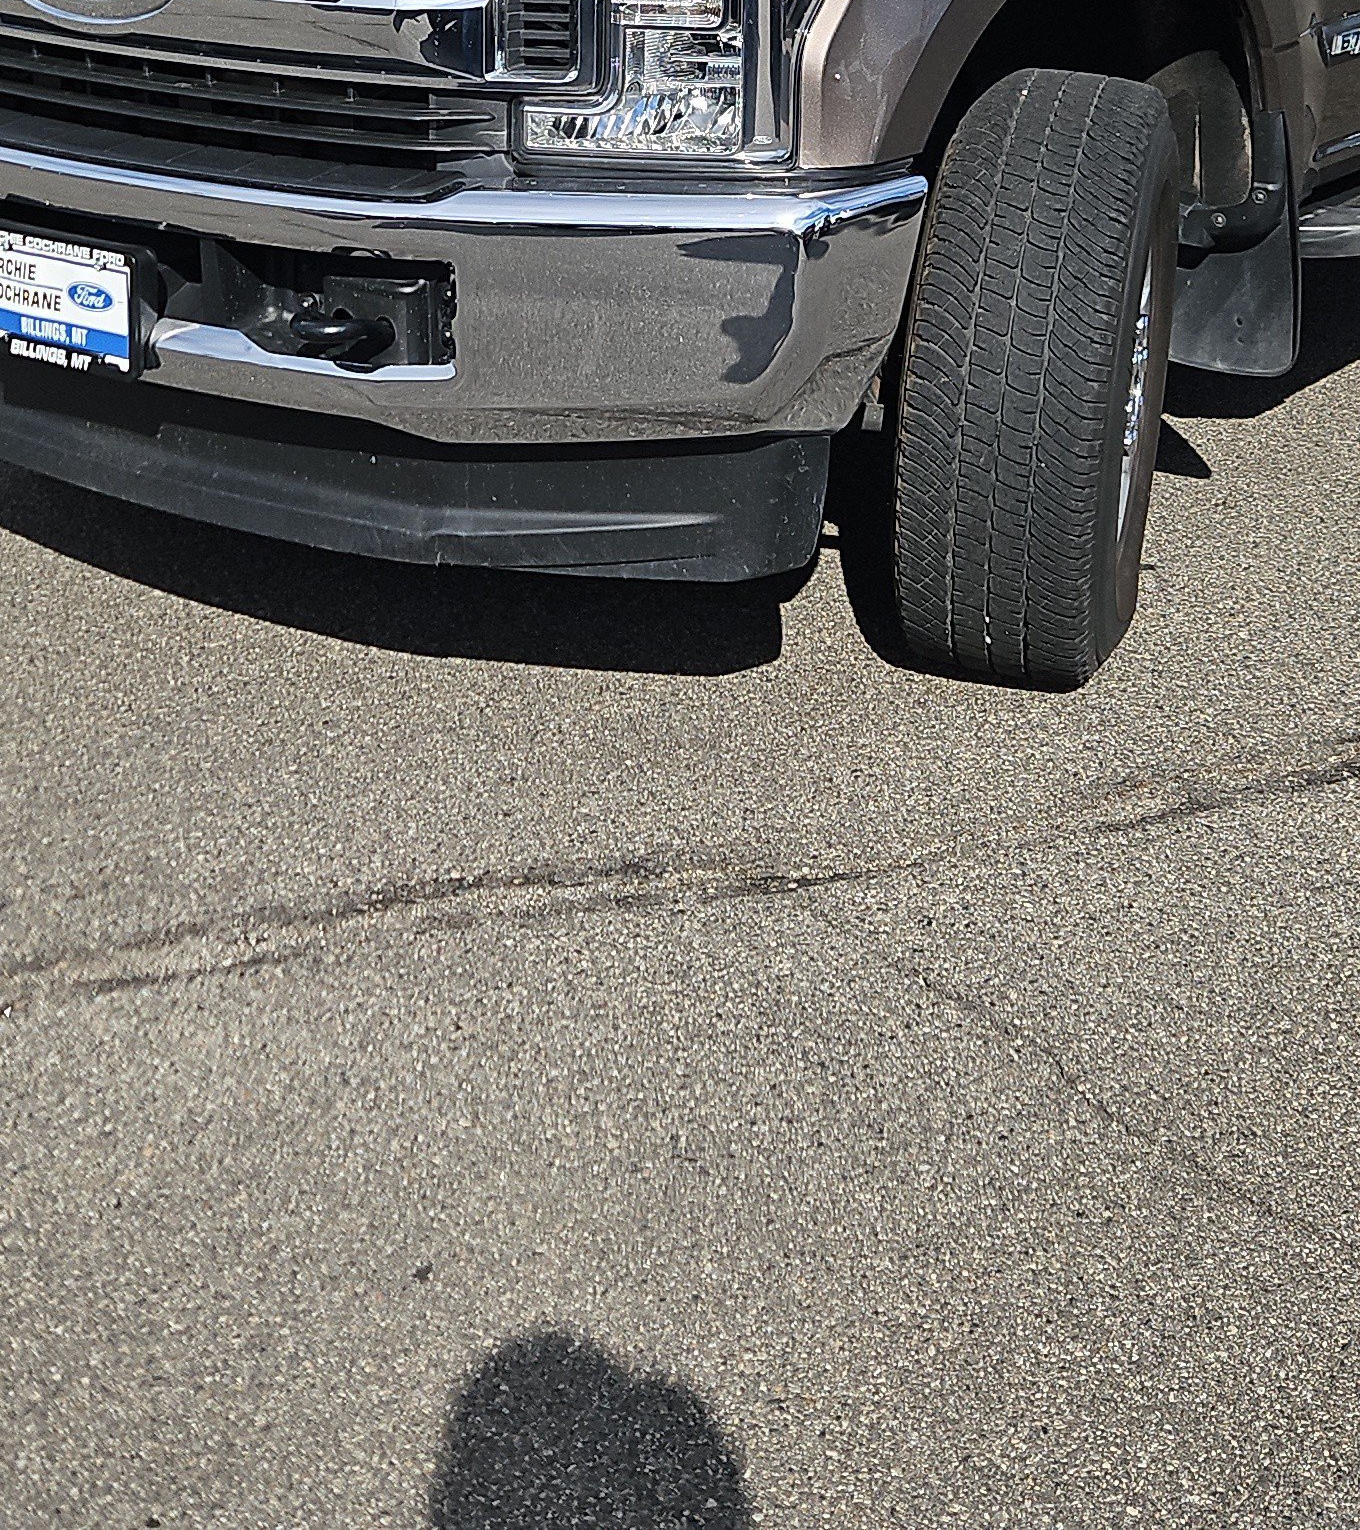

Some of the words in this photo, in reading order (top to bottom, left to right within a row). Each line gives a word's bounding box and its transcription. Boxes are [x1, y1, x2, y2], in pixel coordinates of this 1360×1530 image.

[25, 236, 91, 260] COCHRANE
[74, 285, 107, 308] Ford
[20, 316, 70, 345] BILLINGS,
[71, 328, 89, 347] MT
[10, 339, 68, 368] BILLINGS,
[70, 352, 93, 371] MT
